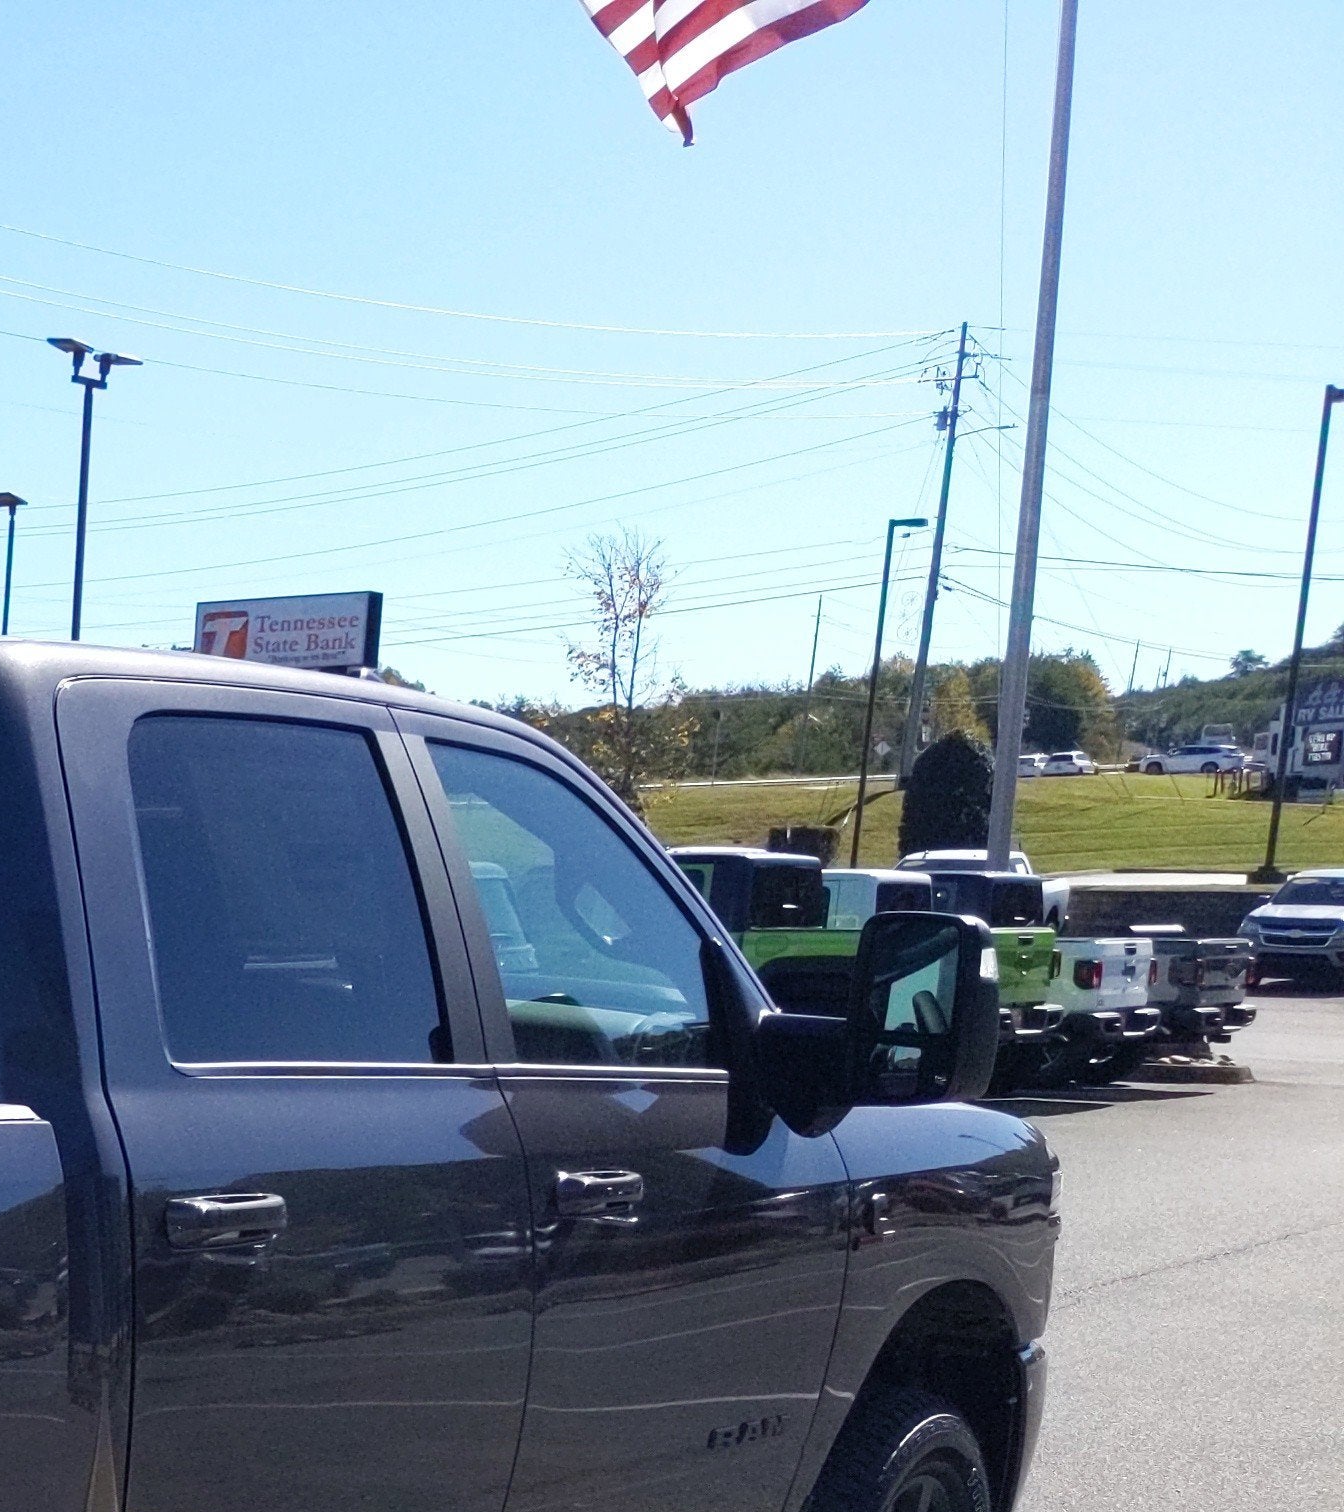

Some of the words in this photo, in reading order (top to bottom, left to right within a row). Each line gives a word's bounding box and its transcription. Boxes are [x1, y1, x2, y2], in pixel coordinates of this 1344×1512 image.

[255, 614, 360, 633] Tennessee
[252, 636, 299, 654] State
[306, 631, 356, 651] Bank
